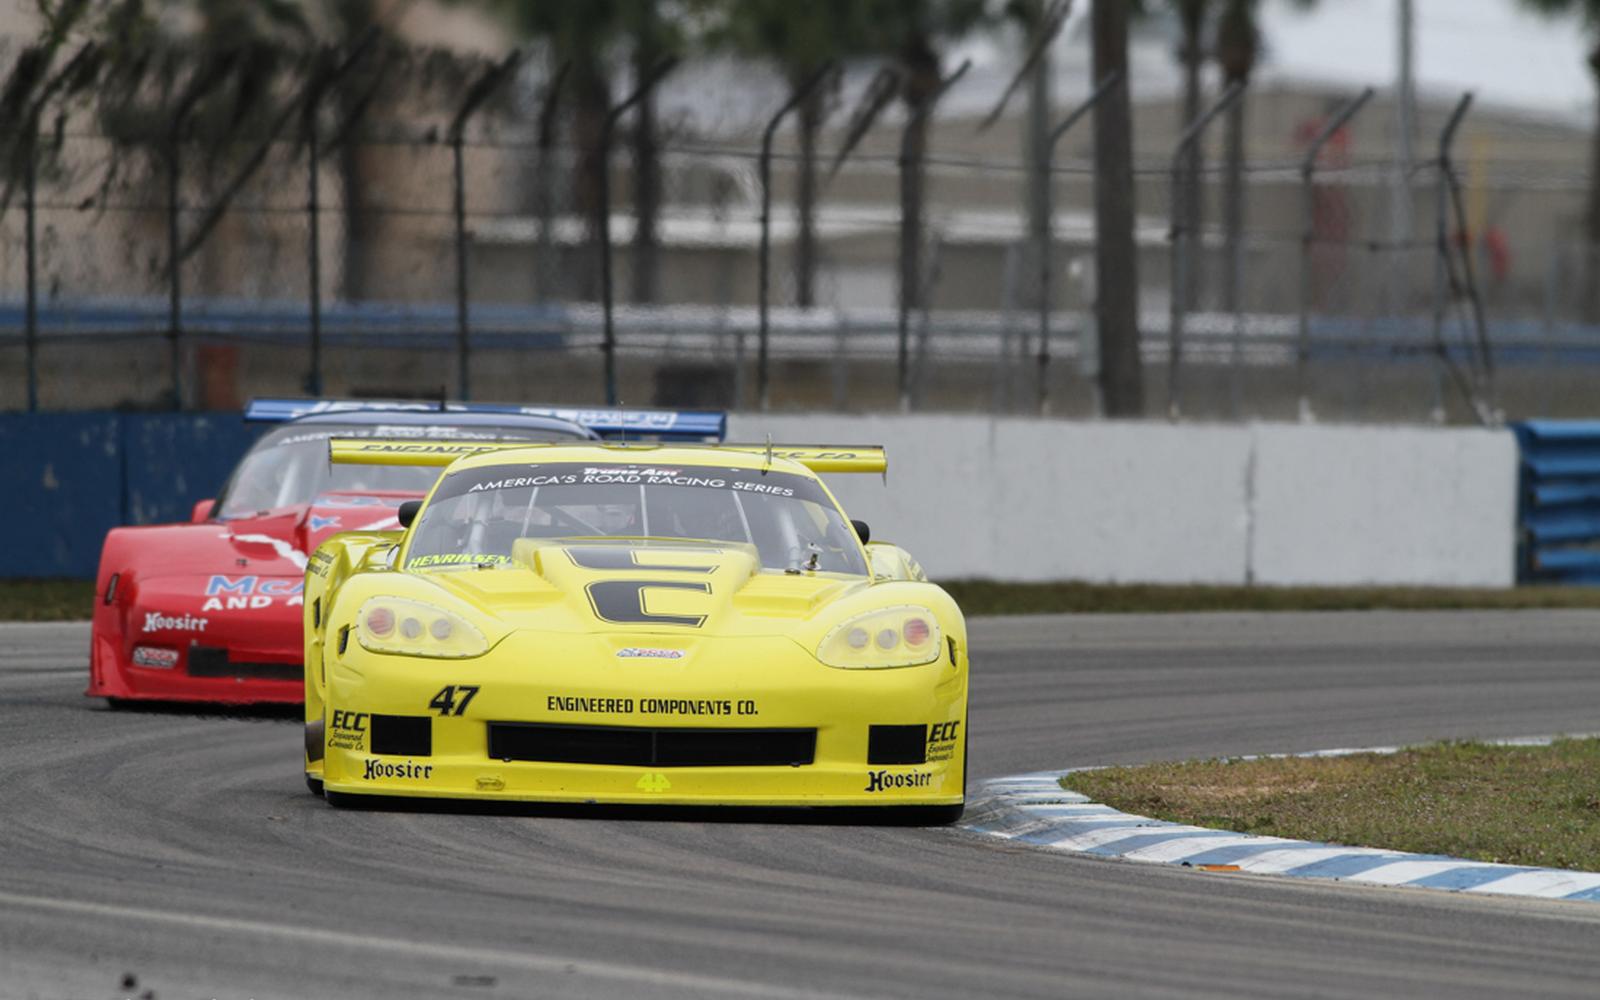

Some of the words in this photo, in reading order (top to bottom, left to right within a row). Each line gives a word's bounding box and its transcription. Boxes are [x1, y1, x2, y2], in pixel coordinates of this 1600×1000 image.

[468, 474, 577, 494] AMERICA'S
[583, 474, 641, 484] ROAD
[647, 475, 726, 488] RACING
[732, 481, 795, 497] SERIES
[406, 553, 511, 569] HENRIKSEN
[201, 596, 273, 612] AND
[142, 612, 208, 632] Hoosier
[428, 684, 481, 717] 47
[547, 695, 634, 714] ENGINEERED
[640, 698, 732, 715] COMPONENTS
[737, 700, 759, 715] CO.
[331, 709, 369, 732] ECC
[928, 720, 961, 743] ECC
[362, 758, 433, 780] Hoosier
[864, 768, 932, 792] Hoosier
